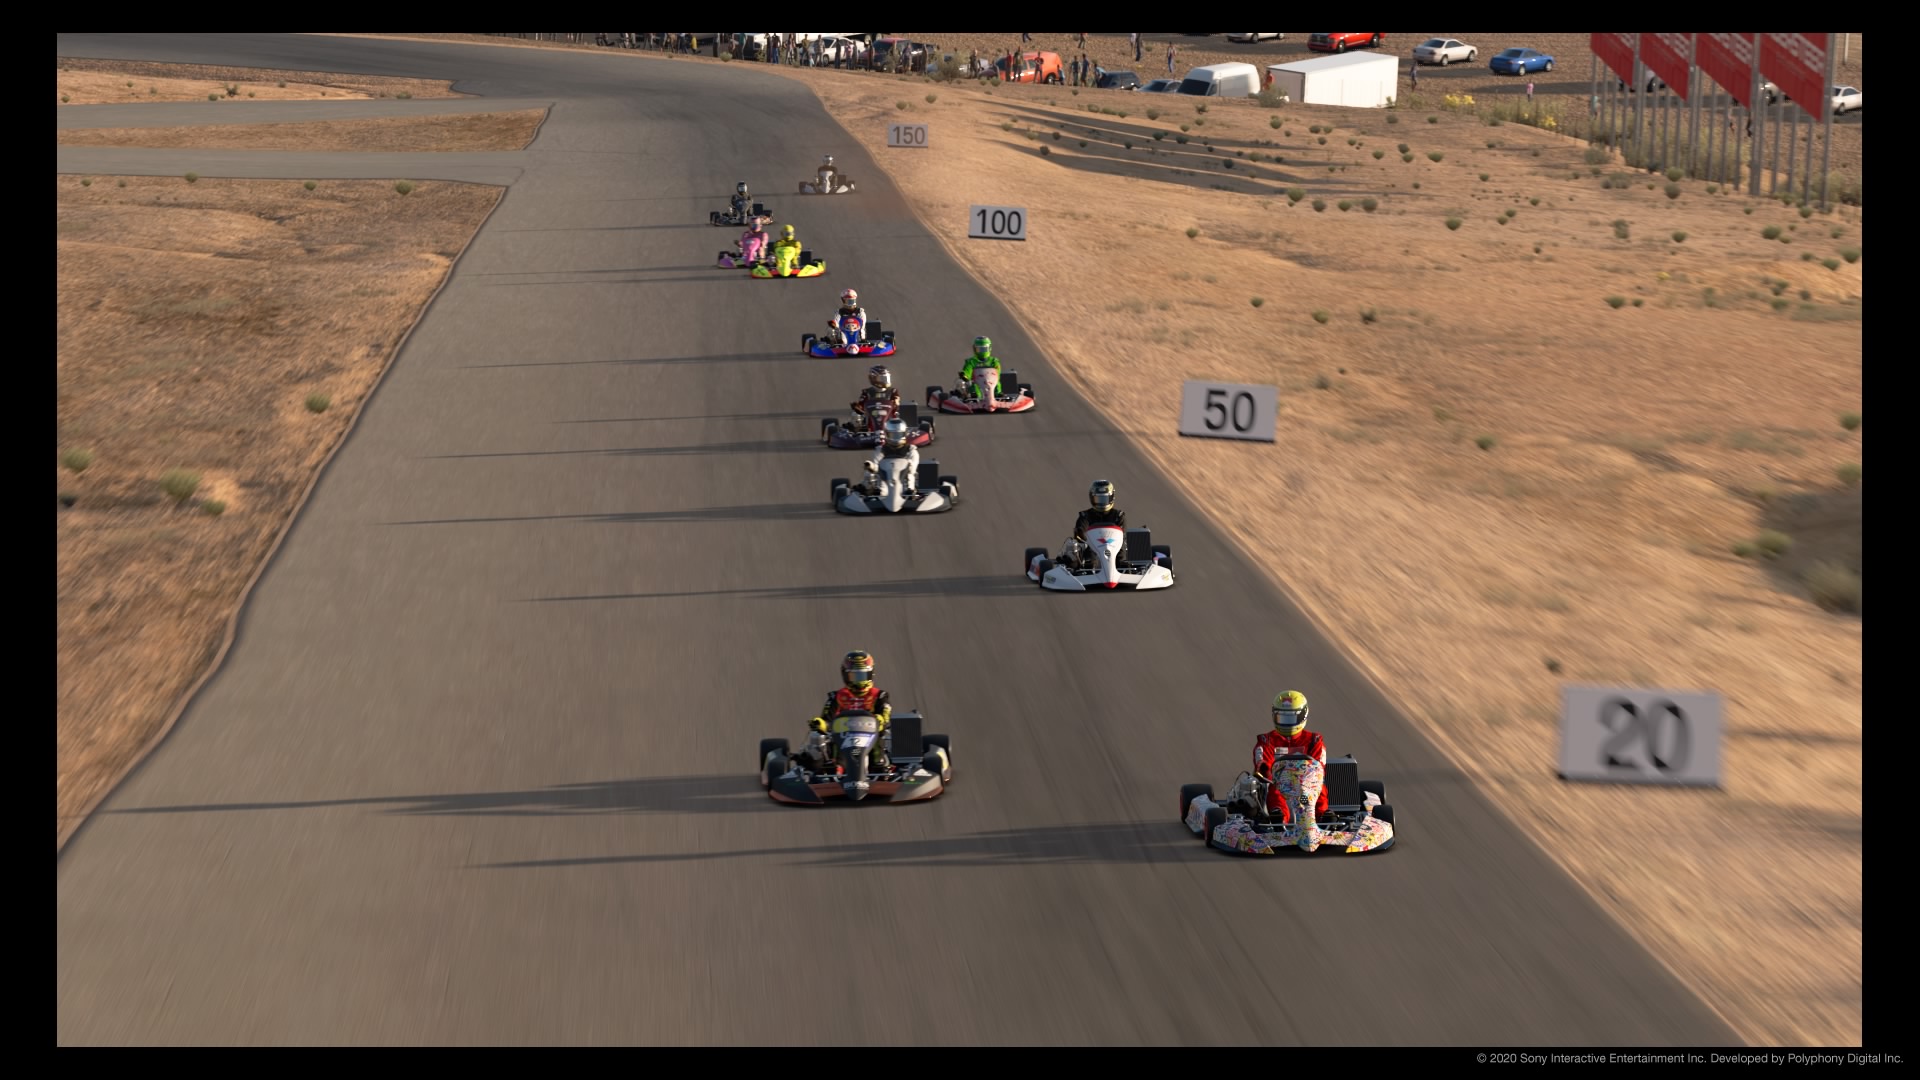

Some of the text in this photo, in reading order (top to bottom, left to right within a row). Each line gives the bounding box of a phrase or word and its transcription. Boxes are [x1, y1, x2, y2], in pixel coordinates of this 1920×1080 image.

[892, 126, 926, 145] 150
[976, 208, 1022, 236] 100
[1204, 389, 1256, 432] 50
[1598, 697, 1692, 773] 20
